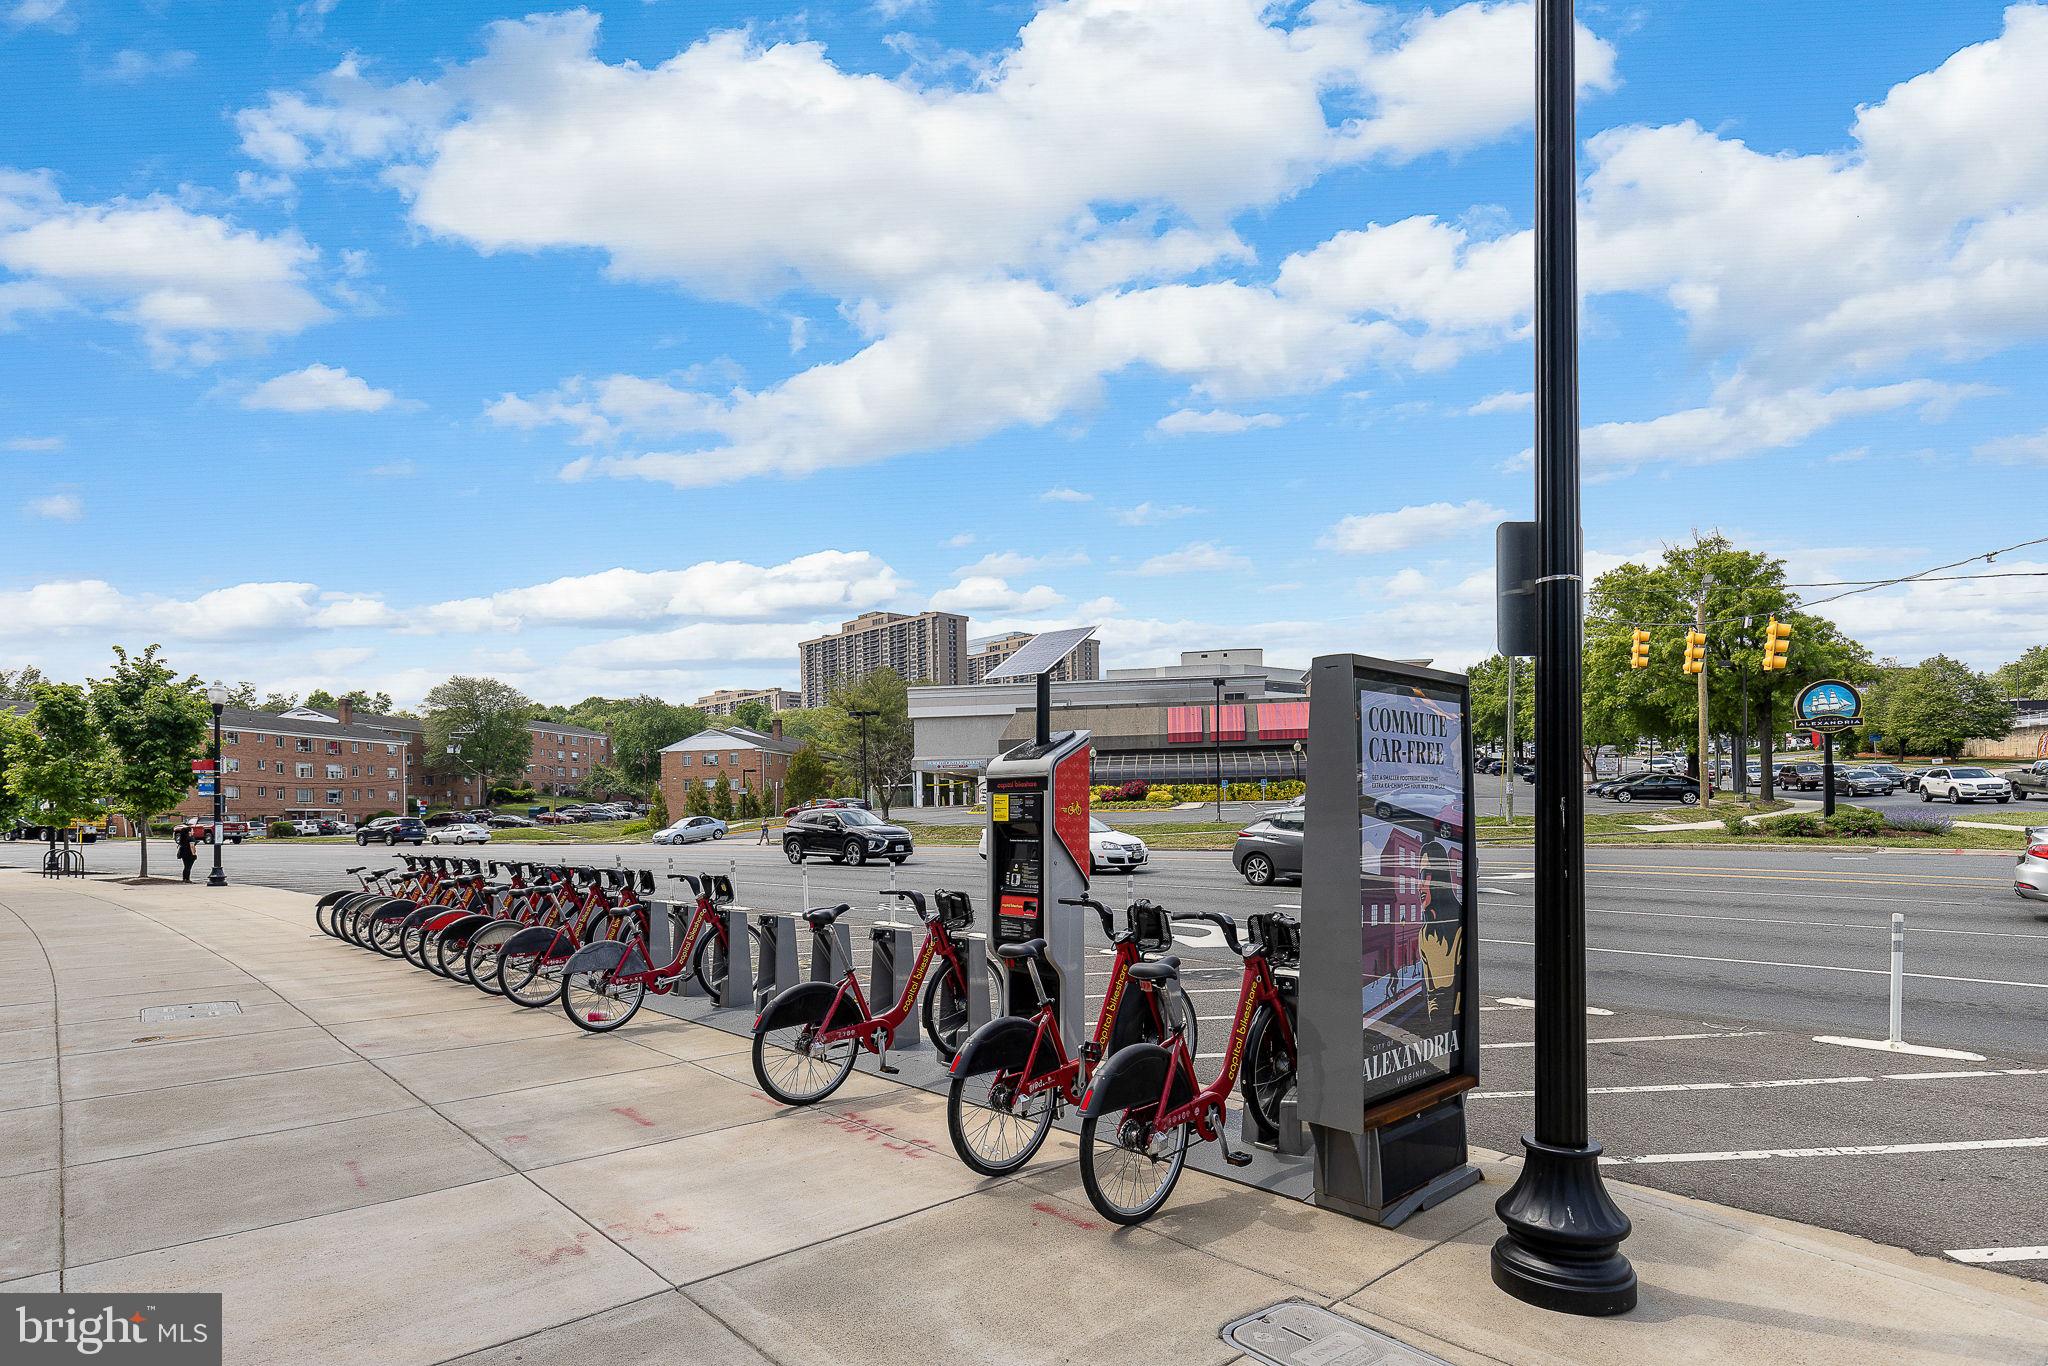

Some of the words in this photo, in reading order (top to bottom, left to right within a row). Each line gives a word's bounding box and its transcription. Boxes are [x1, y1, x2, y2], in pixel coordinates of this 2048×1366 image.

[1369, 707, 1448, 738] COMMUTE
[1369, 737, 1444, 766] CAR-FREE
[679, 941, 692, 965] capital
[903, 981, 918, 1012] capital
[913, 941, 936, 980] bikeshare
[1107, 964, 1128, 1012] bikeshare
[1228, 1037, 1243, 1081] capital
[1236, 981, 1258, 1035] bikeshare
[1362, 1030, 1459, 1082] ALEXANDRIA
[1396, 1068, 1427, 1084] VIRGINIA
